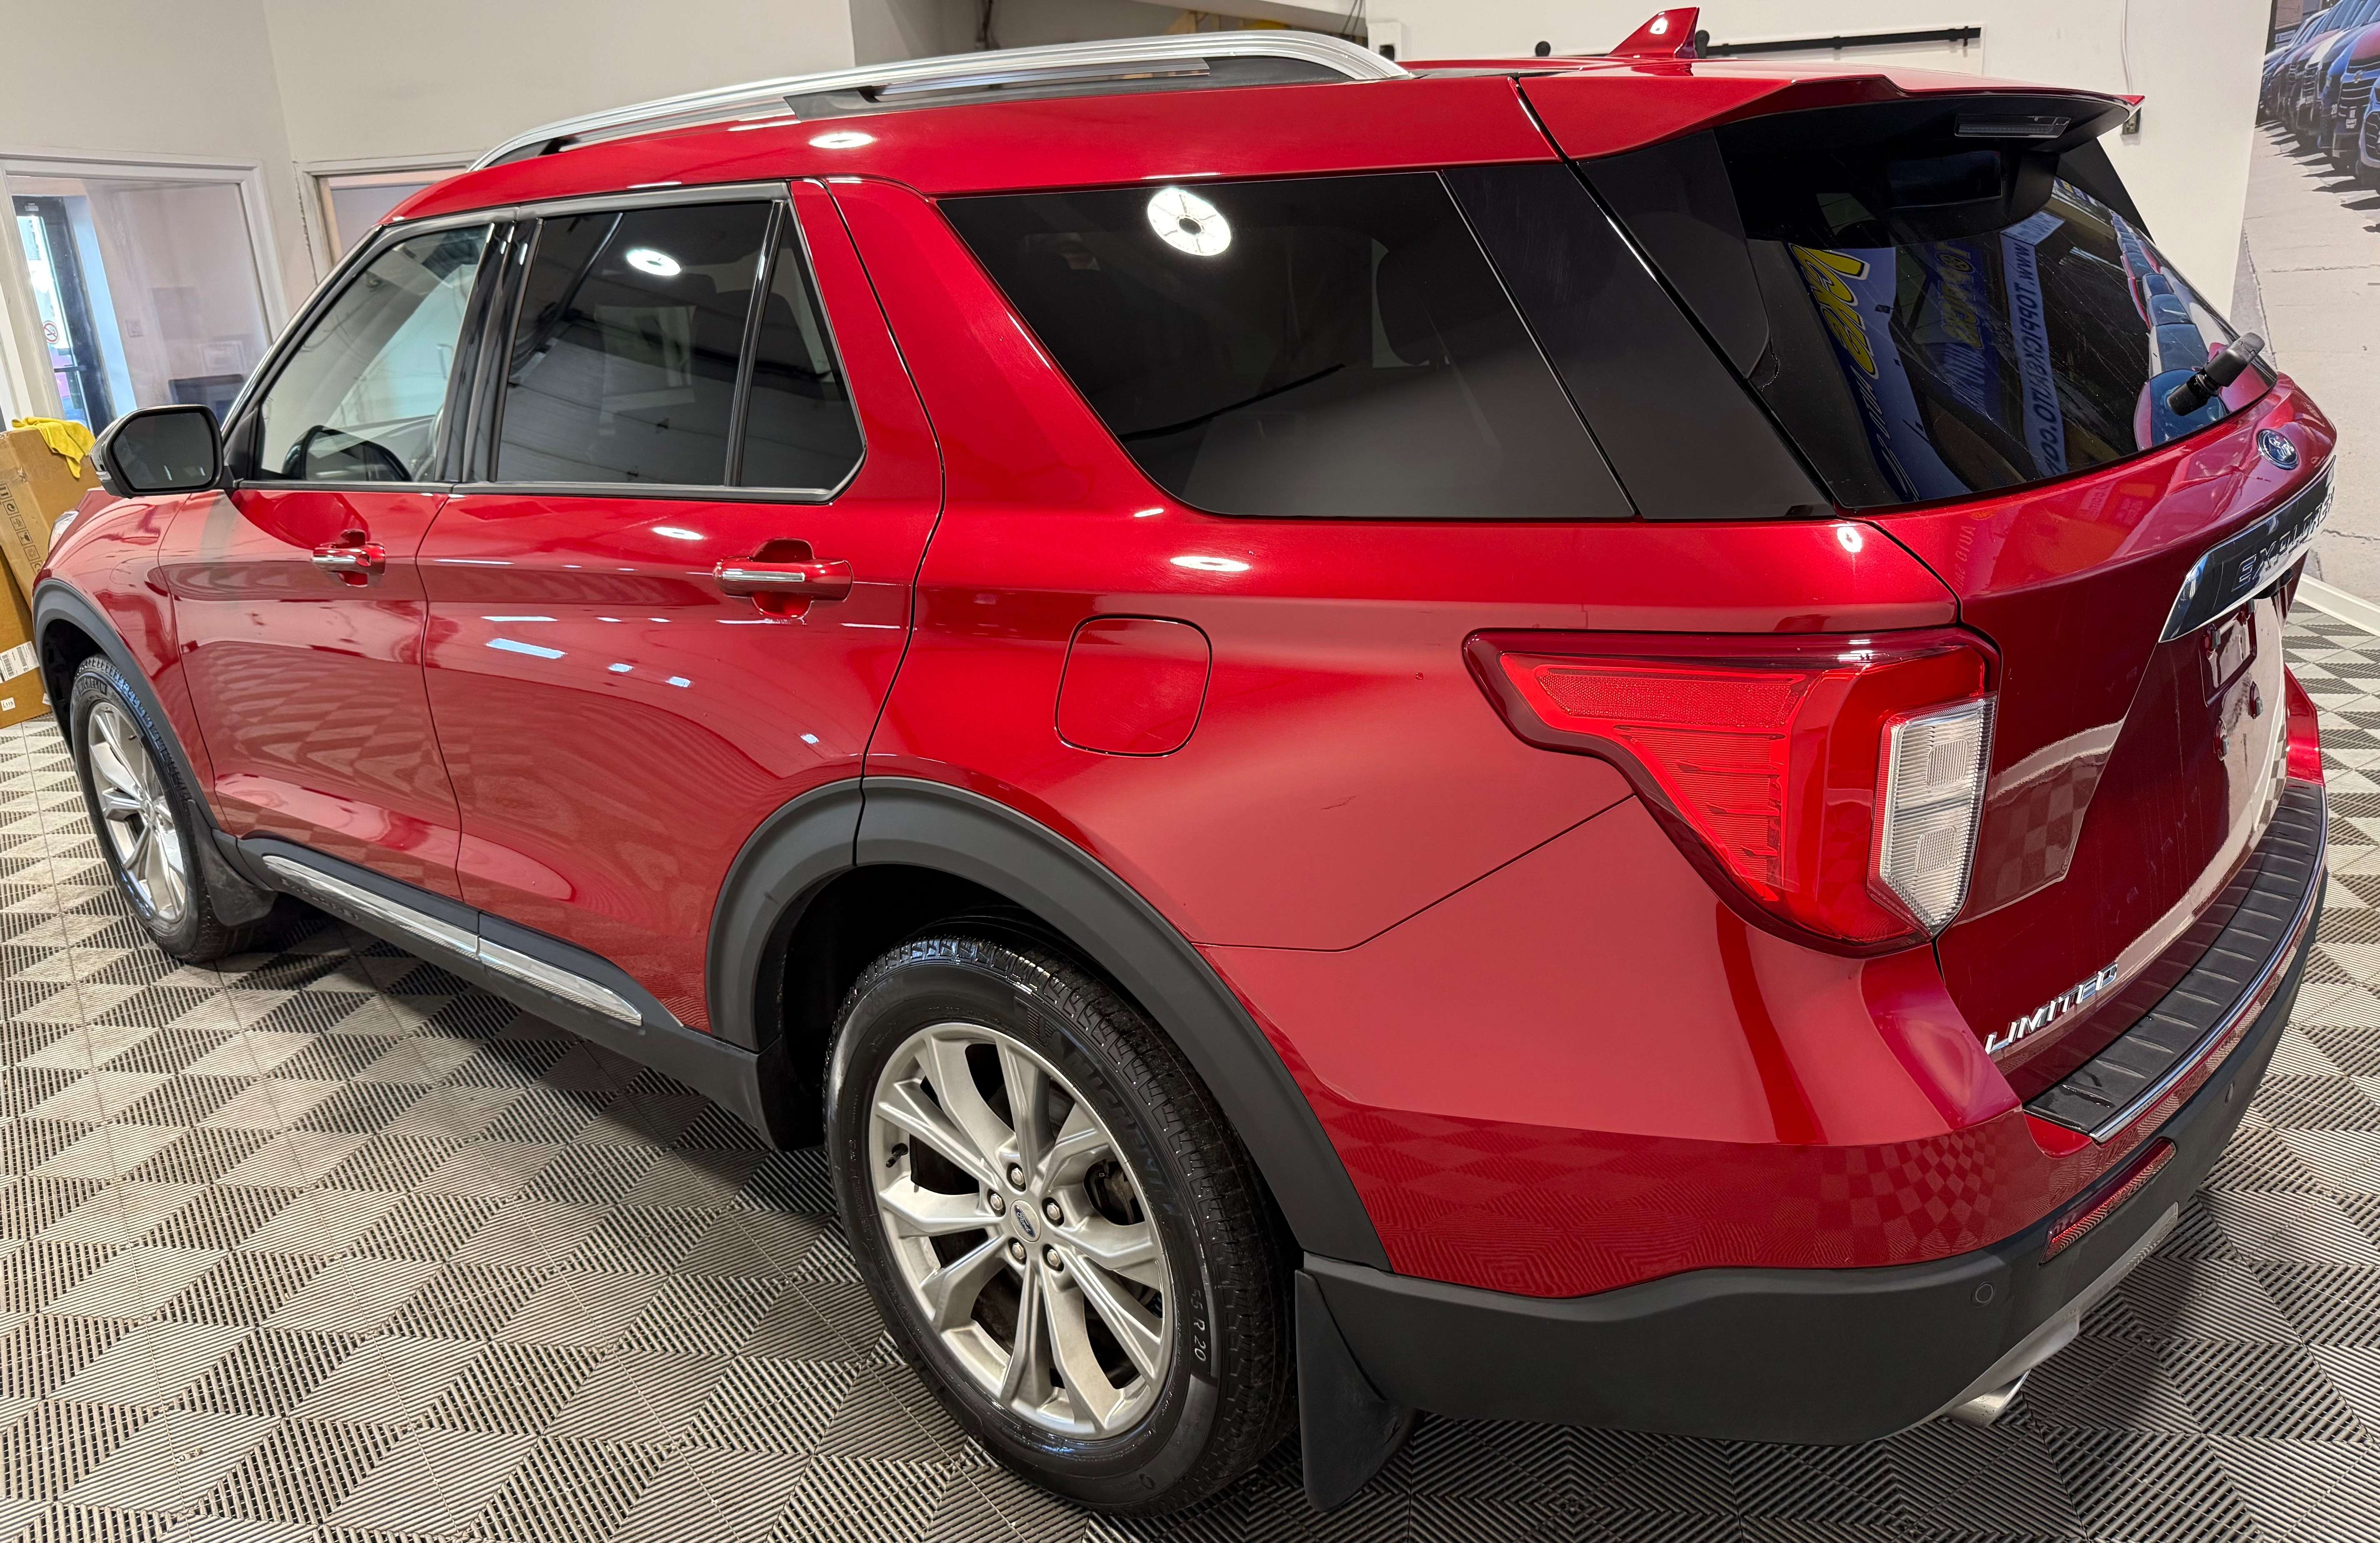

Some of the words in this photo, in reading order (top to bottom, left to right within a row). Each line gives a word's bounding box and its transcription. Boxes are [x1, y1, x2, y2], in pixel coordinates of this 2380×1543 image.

[1984, 961, 2118, 1055] LIMITED
[1016, 1211, 1032, 1232] Ford
[1193, 1316, 1205, 1331] R
[1194, 1335, 1207, 1361] 20
